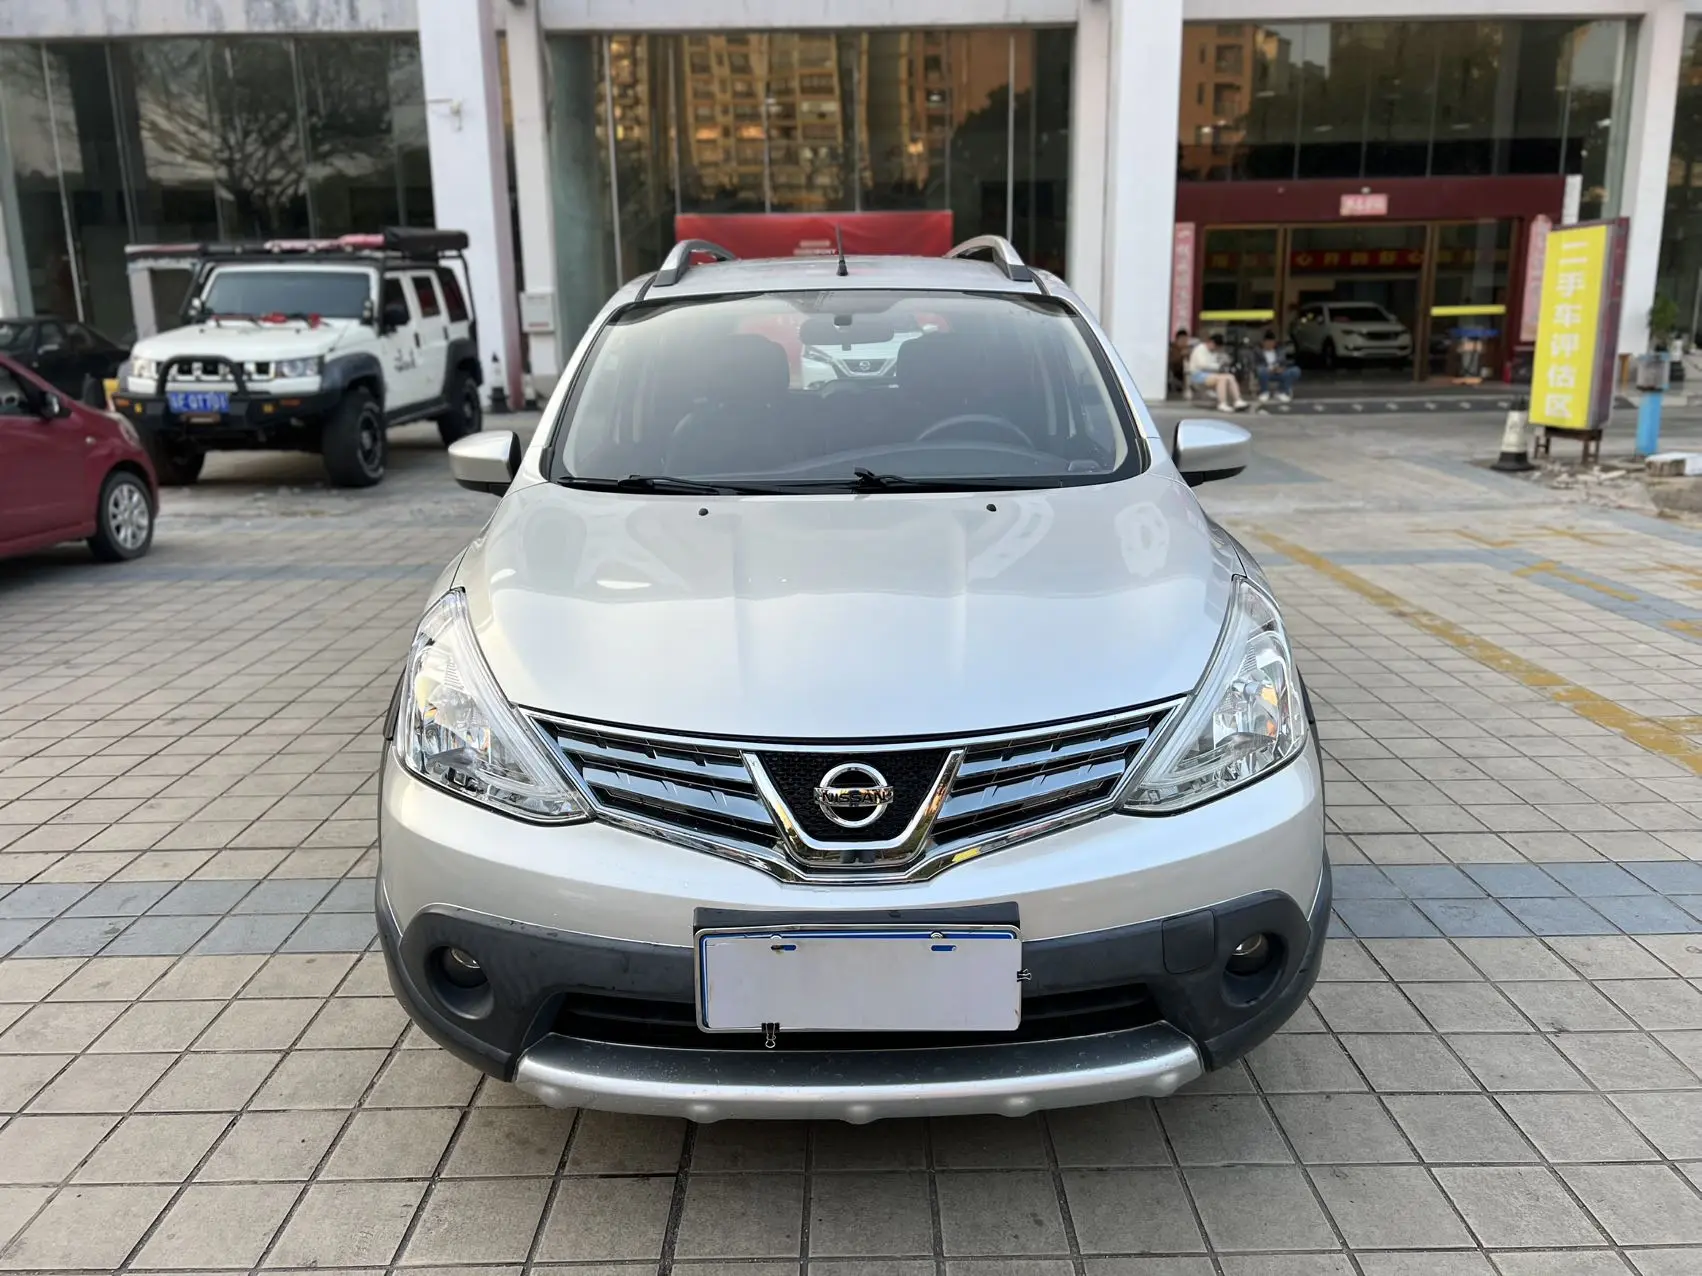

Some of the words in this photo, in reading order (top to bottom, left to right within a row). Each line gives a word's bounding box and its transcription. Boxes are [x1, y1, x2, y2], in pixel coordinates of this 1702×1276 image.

[1545, 241, 1588, 419] 二手车评估区
[821, 790, 887, 804] NISSAN
